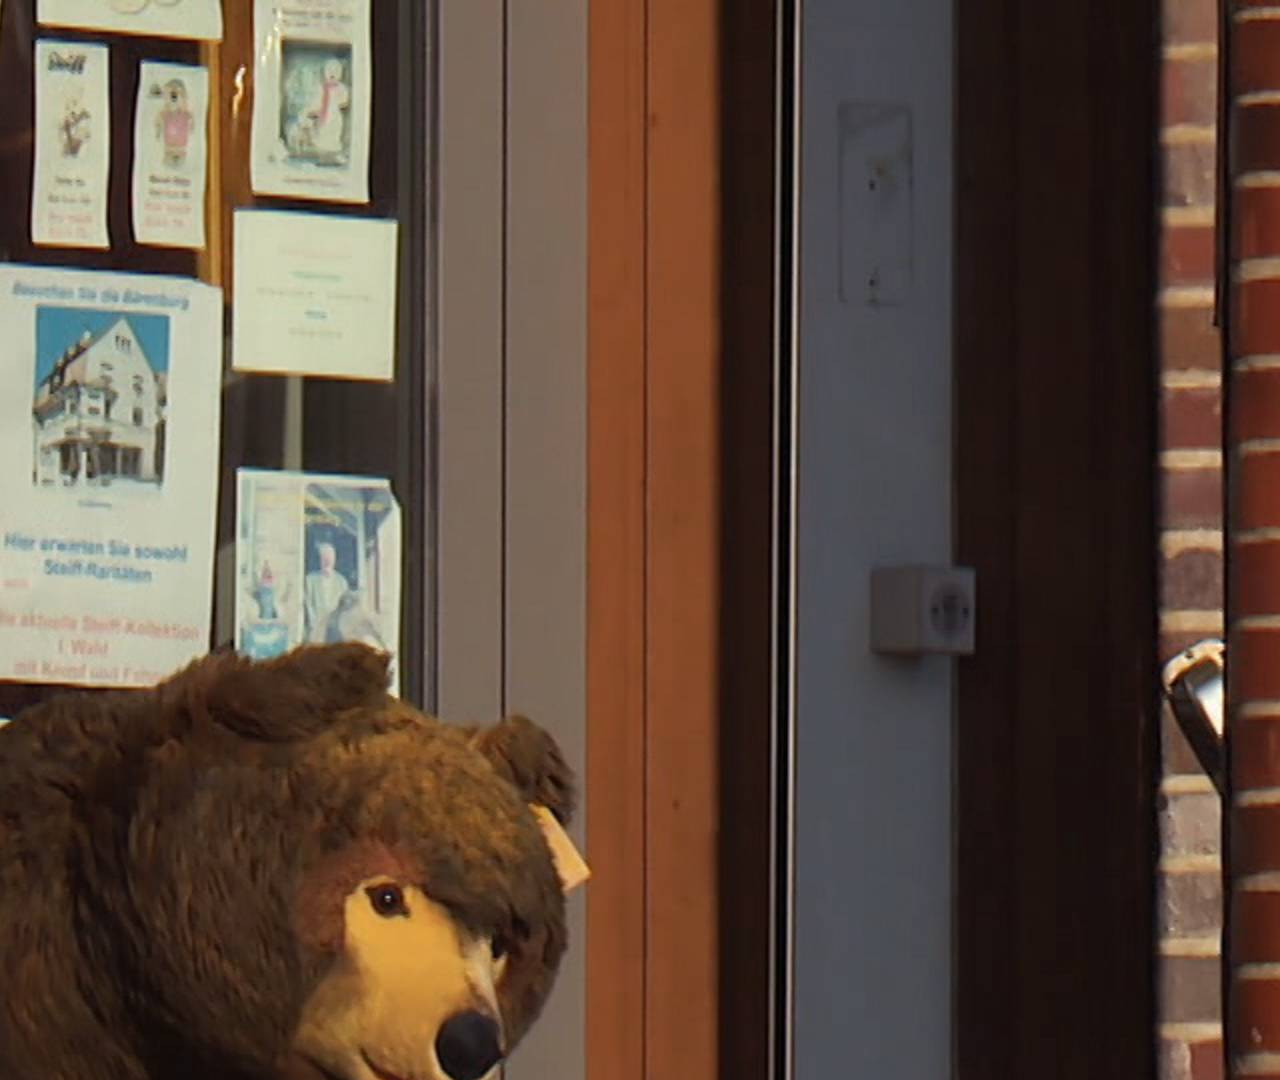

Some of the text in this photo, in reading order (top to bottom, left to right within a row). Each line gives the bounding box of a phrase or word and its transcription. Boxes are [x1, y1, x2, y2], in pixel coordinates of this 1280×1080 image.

[4, 532, 36, 550] Hier
[109, 539, 131, 557] Sie
[135, 545, 188, 563] sowohl
